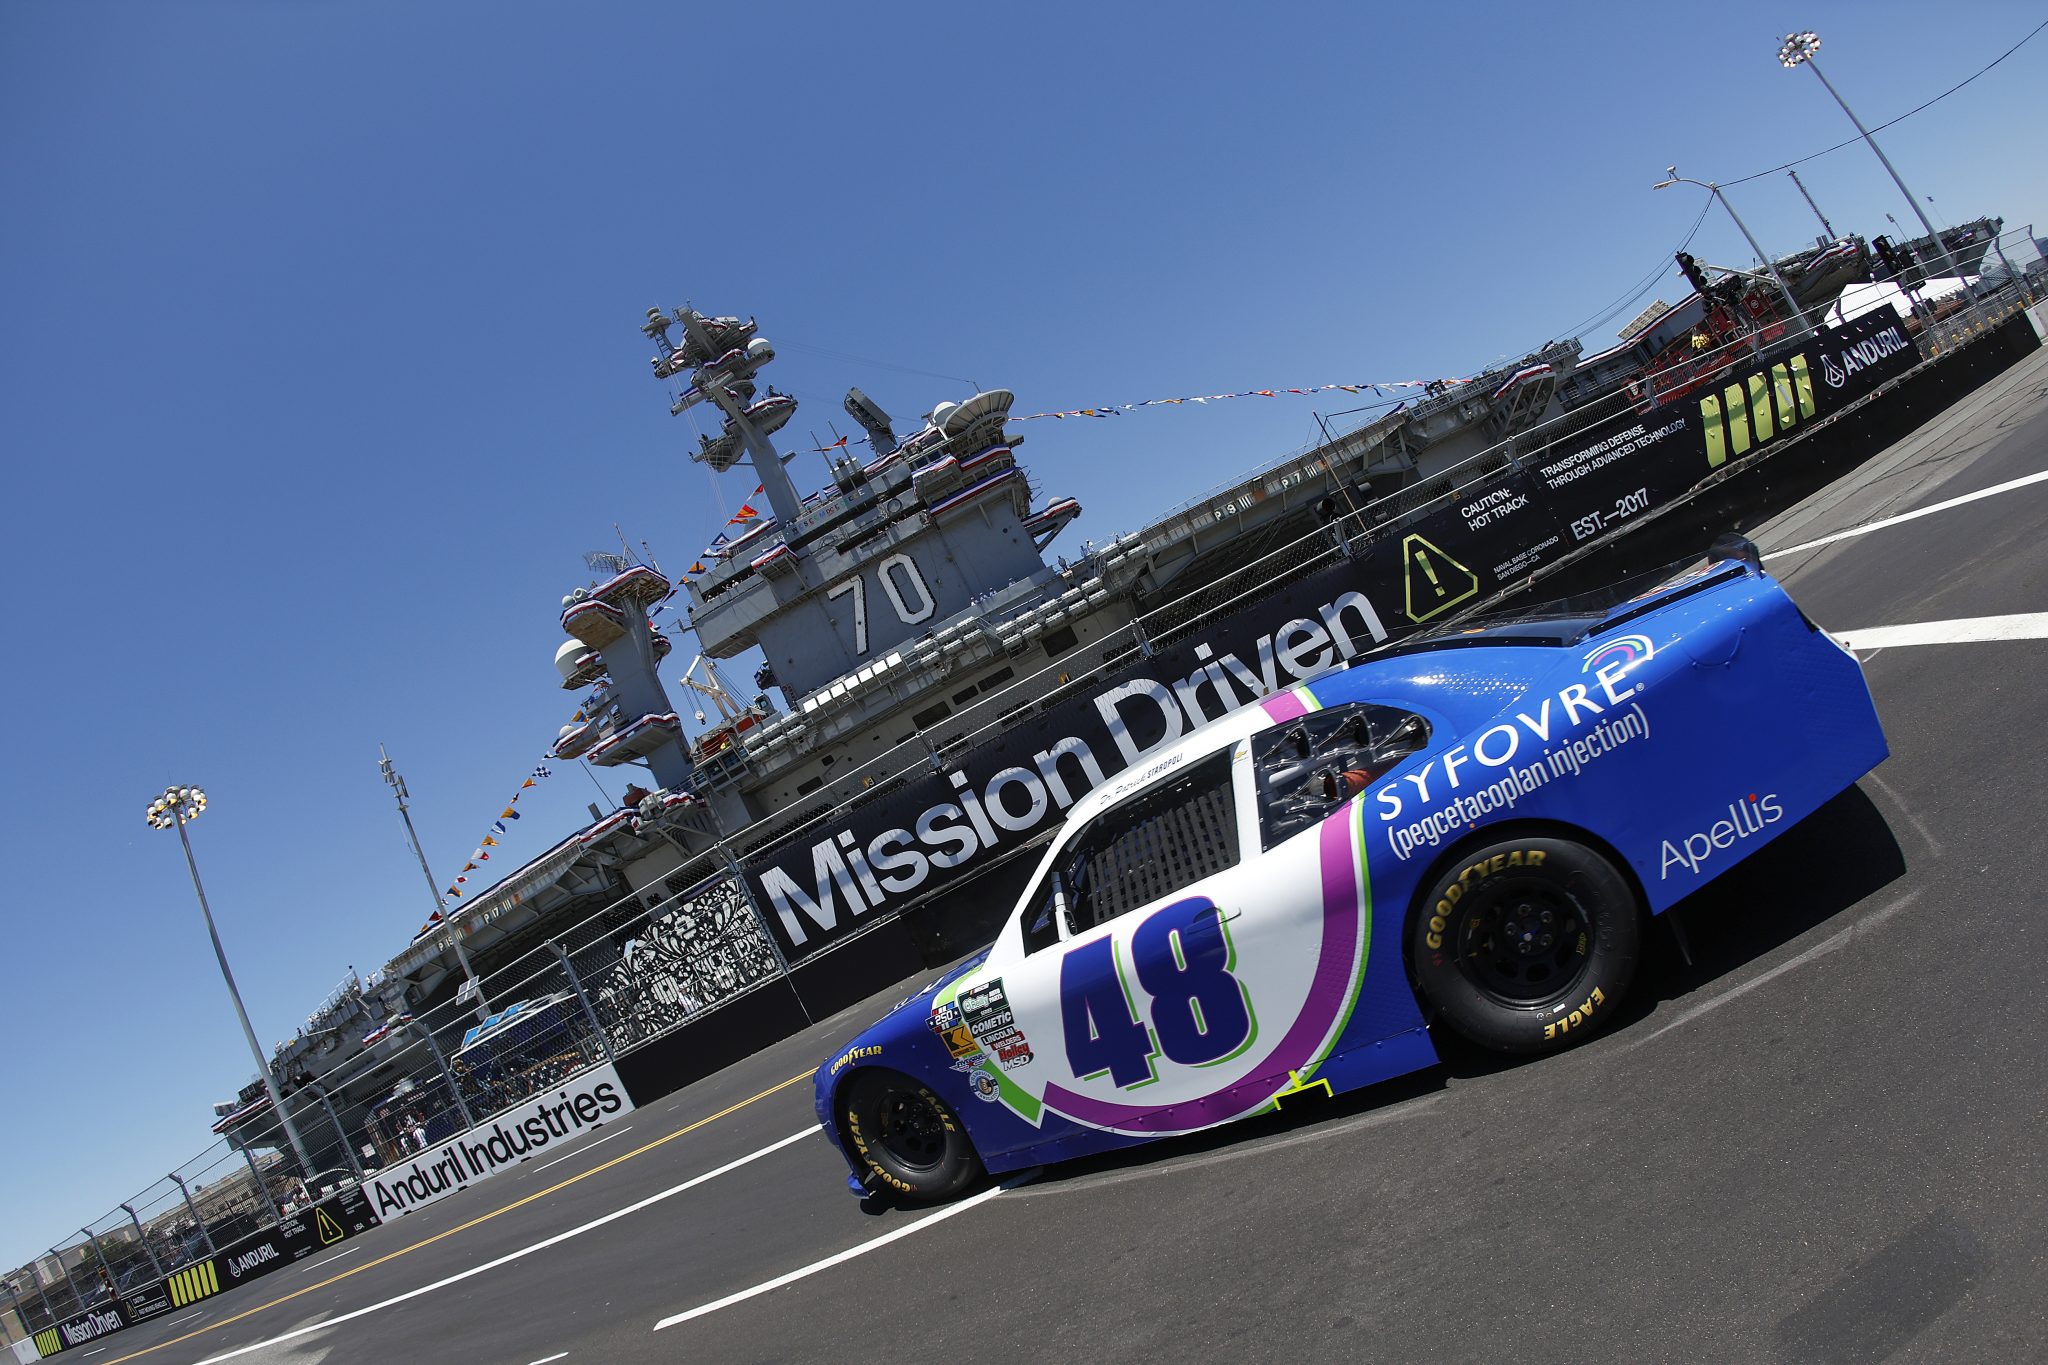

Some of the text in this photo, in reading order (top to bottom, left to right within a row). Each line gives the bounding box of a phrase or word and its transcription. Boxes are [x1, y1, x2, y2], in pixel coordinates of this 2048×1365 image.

[1842, 326, 1909, 376] ANDURIL
[1539, 424, 1646, 479] TRANSFORMING DEFENSE
[1546, 417, 1687, 490] THROUGH ADVANCED TECHNOLOGY
[1213, 503, 1236, 521] P 9
[1461, 488, 1513, 518] CAUTION:
[1467, 494, 1530, 532] HOT TRACK
[1493, 536, 1559, 574] NAVAL BASE CORONADO
[1497, 568, 1509, 581] SAN
[827, 552, 938, 656] 70
[758, 590, 1389, 947] Mission Driven
[1147, 752, 1184, 779] STAROPOLI
[1387, 703, 1651, 861] (pegcetacoplan injection)
[1661, 792, 1784, 881] Apellis
[1426, 850, 1546, 950] GOODYEAR
[1059, 895, 1259, 1091] 48
[934, 1011, 954, 1026] 250
[971, 1010, 1012, 1036] COMETIC
[1543, 986, 1606, 1041] EAGLE
[982, 1027, 1016, 1045] LINCOLN
[993, 1035, 1022, 1050] WELDERS
[998, 1042, 1031, 1061] Holley
[830, 1045, 883, 1076] GOODYEAR
[1003, 1055, 1031, 1072] MSD
[918, 1087, 956, 1133] EAGLE
[374, 1078, 623, 1219] Anduril Industries
[849, 1110, 911, 1193] GOODYEAR
[353, 1222, 365, 1232] USA
[238, 1242, 280, 1272] ANDURIL
[62, 1309, 123, 1346] Mission Driven
